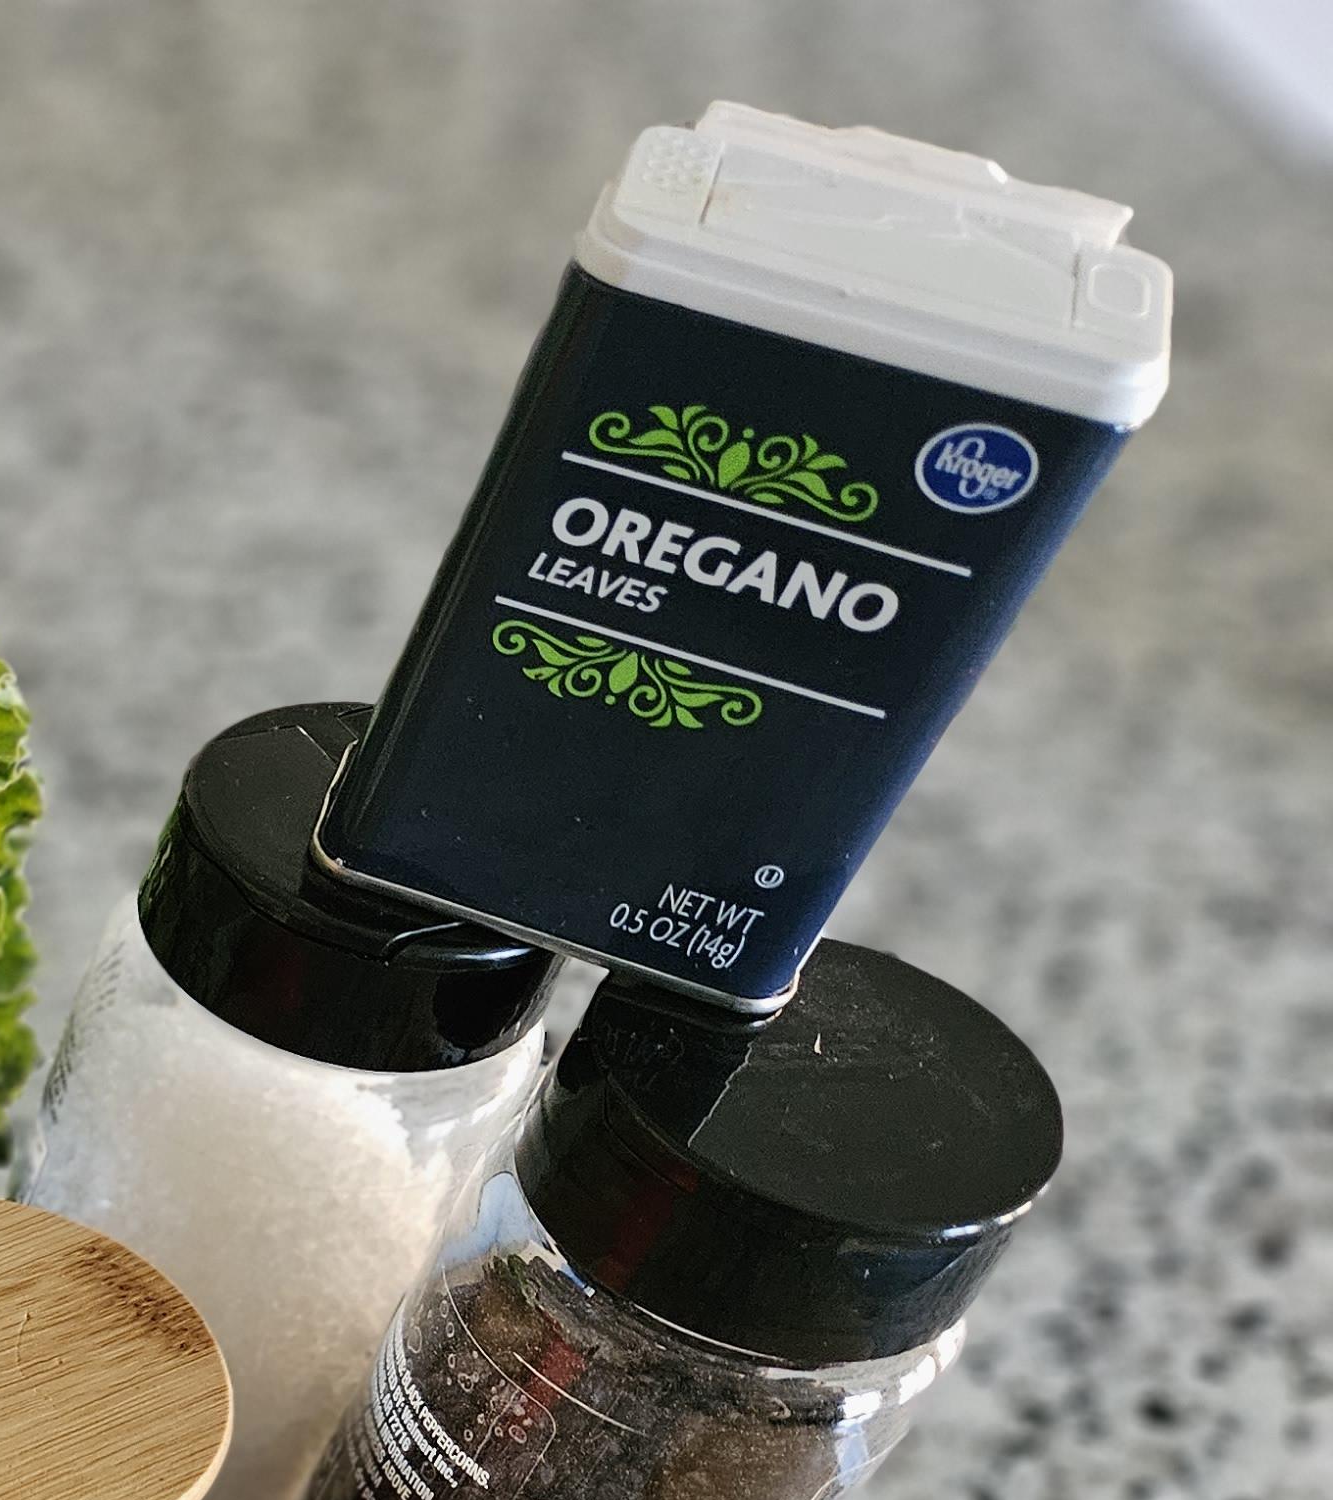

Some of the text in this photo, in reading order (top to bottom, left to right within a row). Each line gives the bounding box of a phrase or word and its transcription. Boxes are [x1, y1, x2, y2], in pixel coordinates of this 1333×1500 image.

[934, 437, 1022, 499] Kroger
[528, 552, 668, 613] LEAVES
[552, 497, 899, 632] OREGANO
[610, 903, 745, 969] 0.5 OZ (14g)
[658, 884, 765, 934] NET WT
[389, 1410, 412, 1452] 72716
[400, 1405, 436, 1462] Walmart
[402, 1370, 490, 1489] BLACK PEPPERCORNS.
